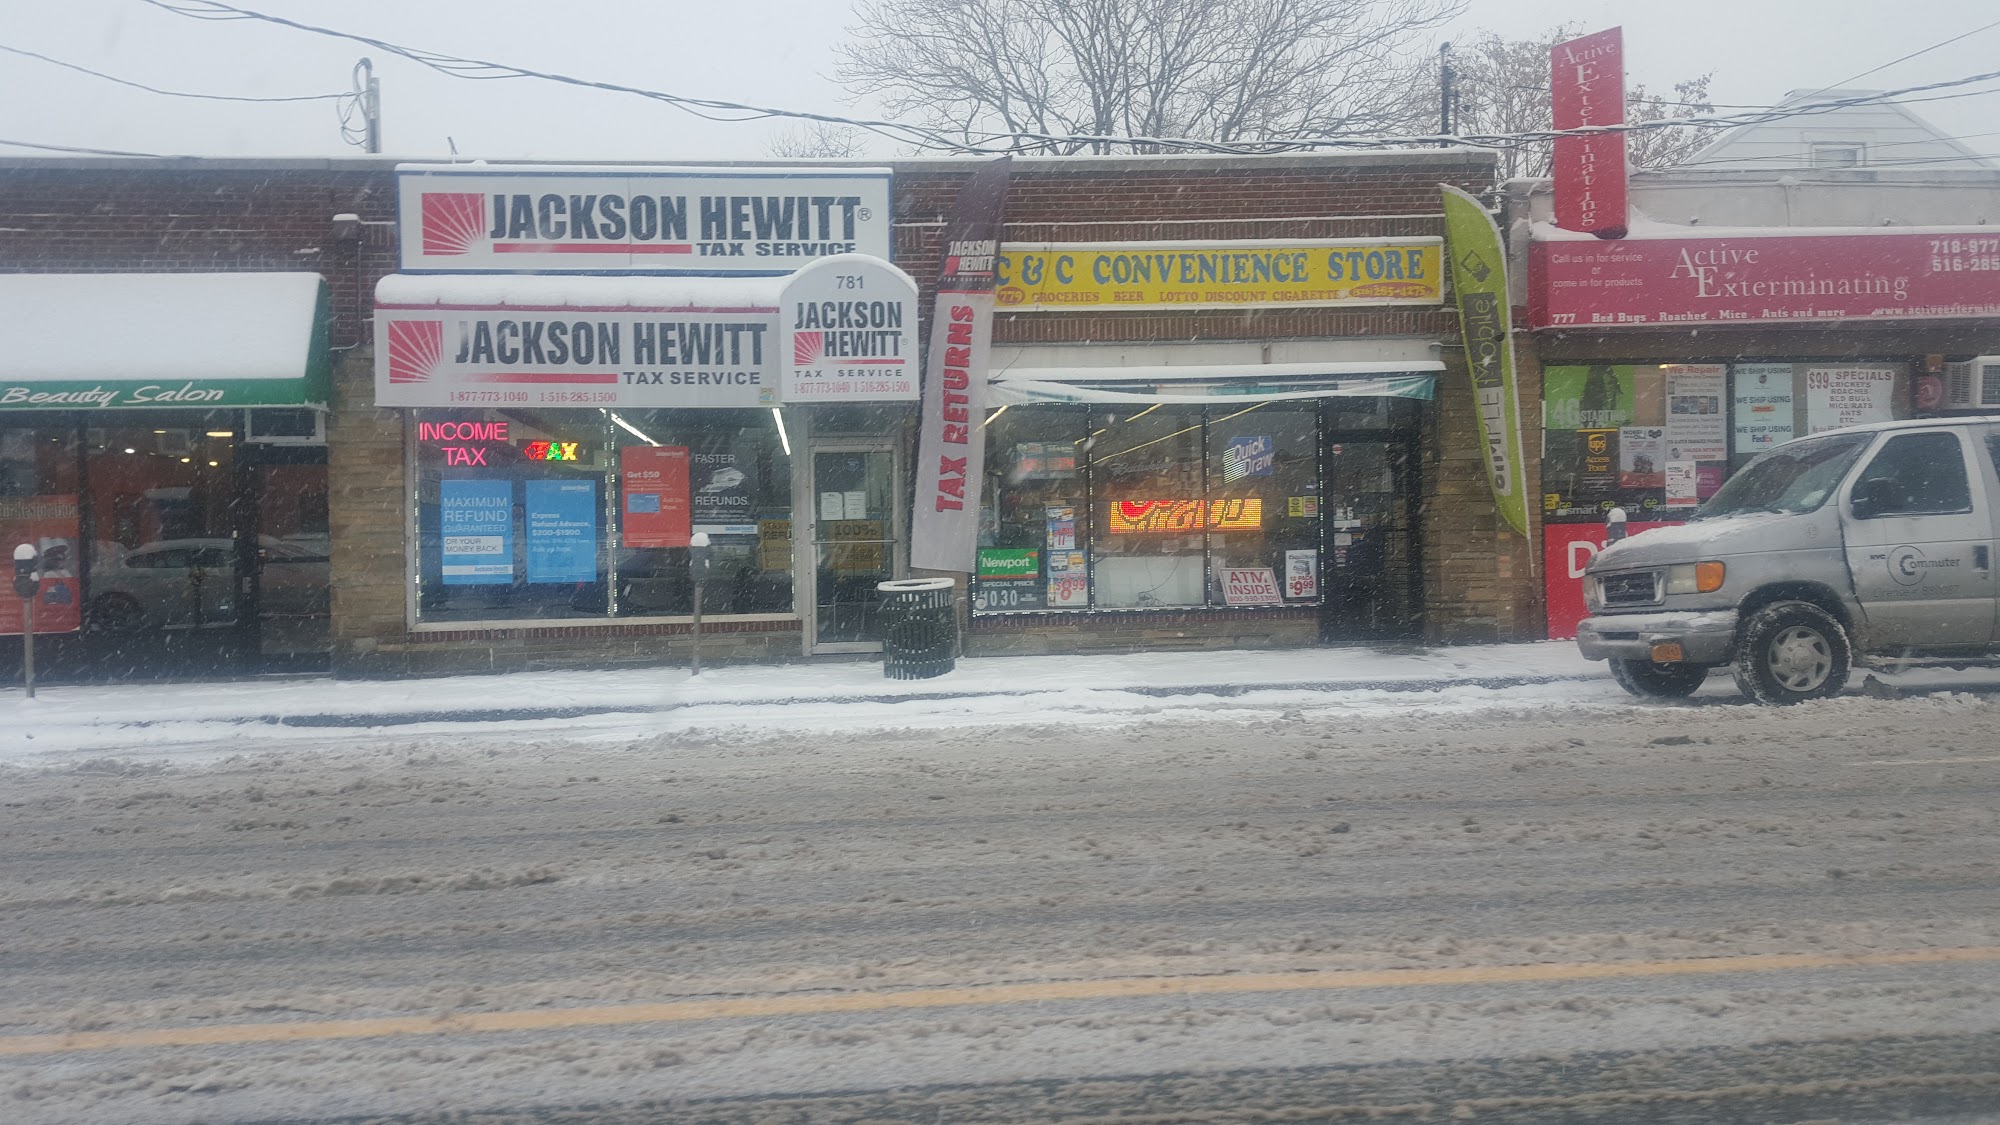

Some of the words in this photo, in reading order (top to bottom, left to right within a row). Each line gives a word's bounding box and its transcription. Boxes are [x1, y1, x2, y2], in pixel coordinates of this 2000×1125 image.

[1559, 43, 1614, 67] Active
[1575, 61, 1600, 226] Exterinating
[490, 194, 688, 240] JACKSON
[700, 196, 861, 240] HEWITT
[696, 242, 745, 256] TAX
[755, 242, 856, 256] SERVICE
[948, 240, 996, 256] JACKSON
[958, 256, 995, 271] HEWITT
[1552, 254, 1570, 263] Call
[1572, 255, 1583, 263] us
[1585, 254, 1594, 262] in
[1596, 254, 1609, 262] for
[1611, 253, 1643, 262] service
[1668, 247, 1759, 279] Active
[1021, 255, 1044, 286] &
[1056, 255, 1074, 284] C
[1092, 252, 1309, 285] CONVENIENCE
[1327, 249, 1425, 281] STORE
[1592, 267, 1601, 275] or
[836, 276, 864, 289] 781
[1553, 280, 1577, 288] come
[1579, 279, 1587, 287] in
[1590, 278, 1602, 287] for
[1605, 278, 1643, 288] products
[1695, 266, 1909, 301] Exterminating
[1031, 291, 1100, 303] GROCERIES
[1113, 291, 1144, 301] BEER
[1159, 291, 1199, 301] LOTTO
[1204, 291, 1266, 302] DISCOUNT
[794, 302, 902, 329] JACKSON
[1552, 313, 1576, 323] 777
[1592, 312, 1613, 322] Bed
[1617, 312, 1646, 324] Bugs
[1659, 311, 1707, 321] Roaches
[1719, 309, 1747, 319] Mice
[1762, 308, 1788, 318] Ants
[1793, 308, 1812, 317] and
[1818, 308, 1845, 317] more
[455, 320, 621, 365] JACKSON
[634, 322, 767, 365] HEWITT
[824, 330, 902, 357] HEWITT
[1469, 299, 1499, 384] Mobile
[794, 370, 823, 378] TAX
[838, 369, 903, 377] SERVICE
[943, 304, 974, 446] RETURNS
[1687, 365, 1721, 376] Repair
[623, 371, 664, 385] TAX
[670, 371, 761, 385] SERVICE
[1808, 371, 1829, 389] $99
[1835, 371, 1892, 381] SPECIALS
[1, 386, 119, 407] Beauty
[123, 381, 225, 403] Salon
[450, 391, 529, 402] 1-877-773-1040
[540, 391, 617, 402] 1-516-285-1500
[1749, 396, 1766, 404] SHIP
[420, 422, 508, 441] INCOME
[1769, 425, 1791, 433] USING
[1752, 434, 1773, 443] FedEx
[1232, 436, 1265, 461] Quick
[441, 447, 487, 466] TAX
[694, 453, 736, 463] FASTER
[1585, 455, 1610, 463] Access
[1243, 452, 1276, 476] Draw
[1587, 464, 1608, 472] Point
[643, 470, 660, 479] $50
[936, 455, 968, 512] TAX
[444, 497, 507, 508] MAXIMUM
[1566, 505, 1598, 514] smart
[444, 510, 507, 522] REFUND
[531, 512, 560, 520] Express
[444, 524, 506, 532] GUARANTEED
[982, 557, 1030, 569] Newport
[1899, 554, 1961, 576] Commuter
[1230, 571, 1268, 584] ATM
[1229, 584, 1274, 595] INSIDE
